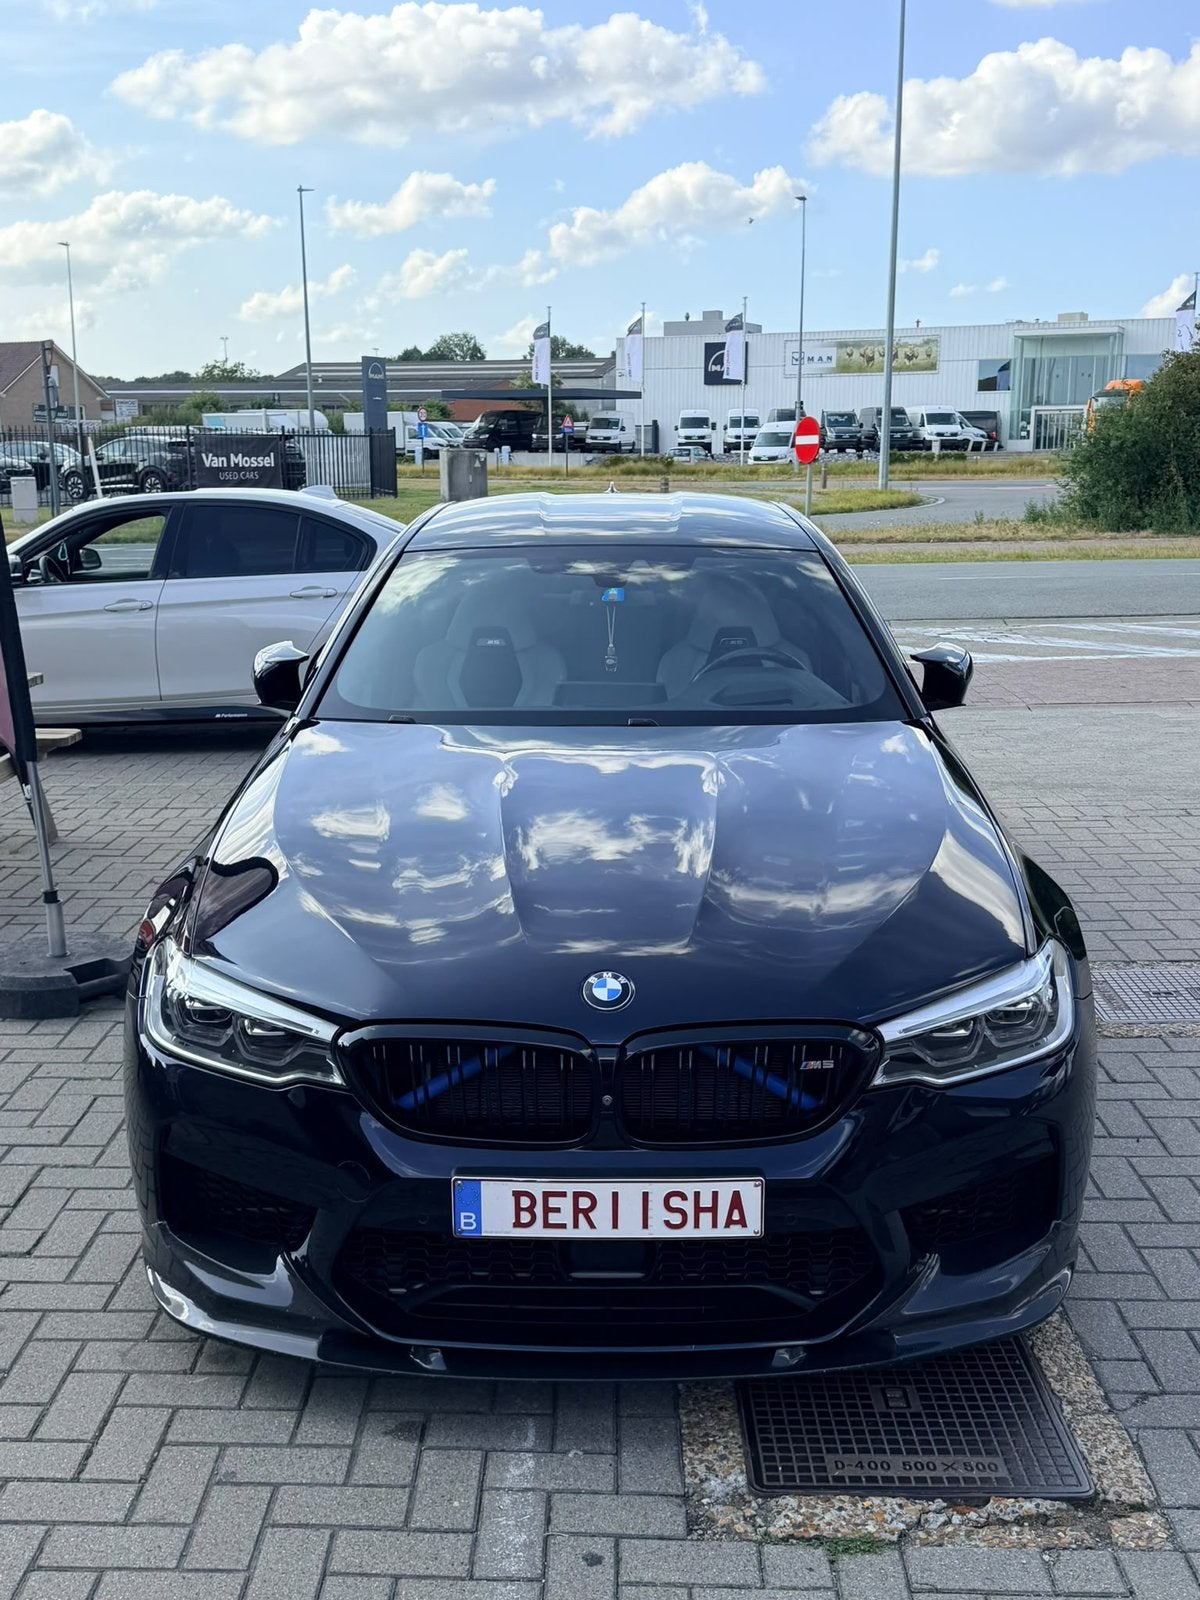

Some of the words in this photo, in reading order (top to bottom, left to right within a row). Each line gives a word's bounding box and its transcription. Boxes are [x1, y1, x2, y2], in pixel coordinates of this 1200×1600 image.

[201, 453, 227, 467] Van
[230, 452, 275, 467] Mossel
[219, 471, 239, 480] USED
[240, 471, 259, 480] CARS
[588, 971, 628, 984] BMW
[460, 1212, 477, 1230] B
[833, 1460, 892, 1472] D-400
[901, 1461, 937, 1473] 500
[963, 1461, 999, 1474] 500
